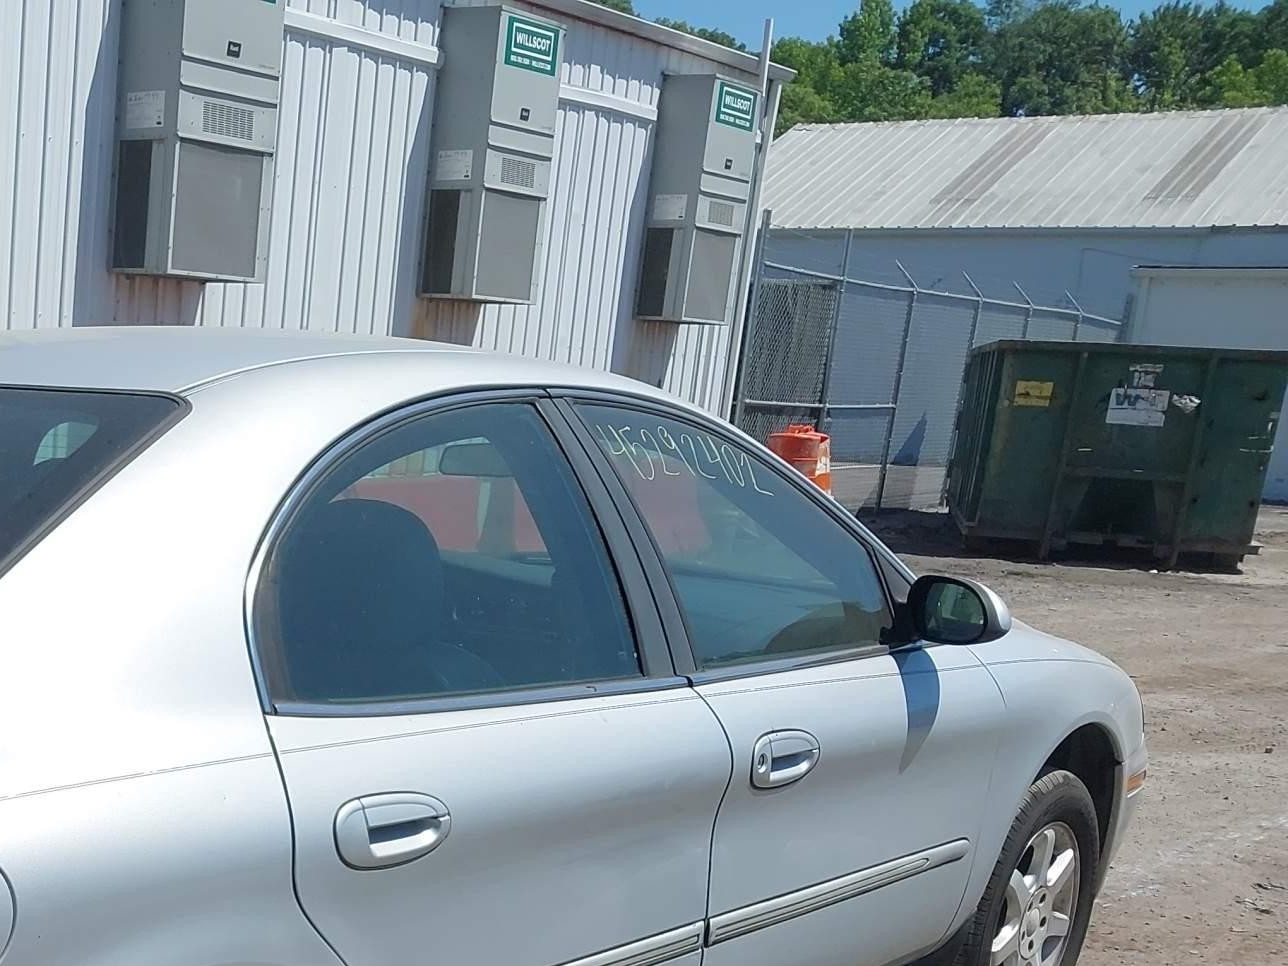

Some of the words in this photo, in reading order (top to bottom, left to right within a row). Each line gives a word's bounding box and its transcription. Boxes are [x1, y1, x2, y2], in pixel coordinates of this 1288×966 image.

[516, 31, 551, 52] WILLSCOT
[725, 94, 750, 112] WILLSCOT
[596, 424, 774, 496] 45292402
